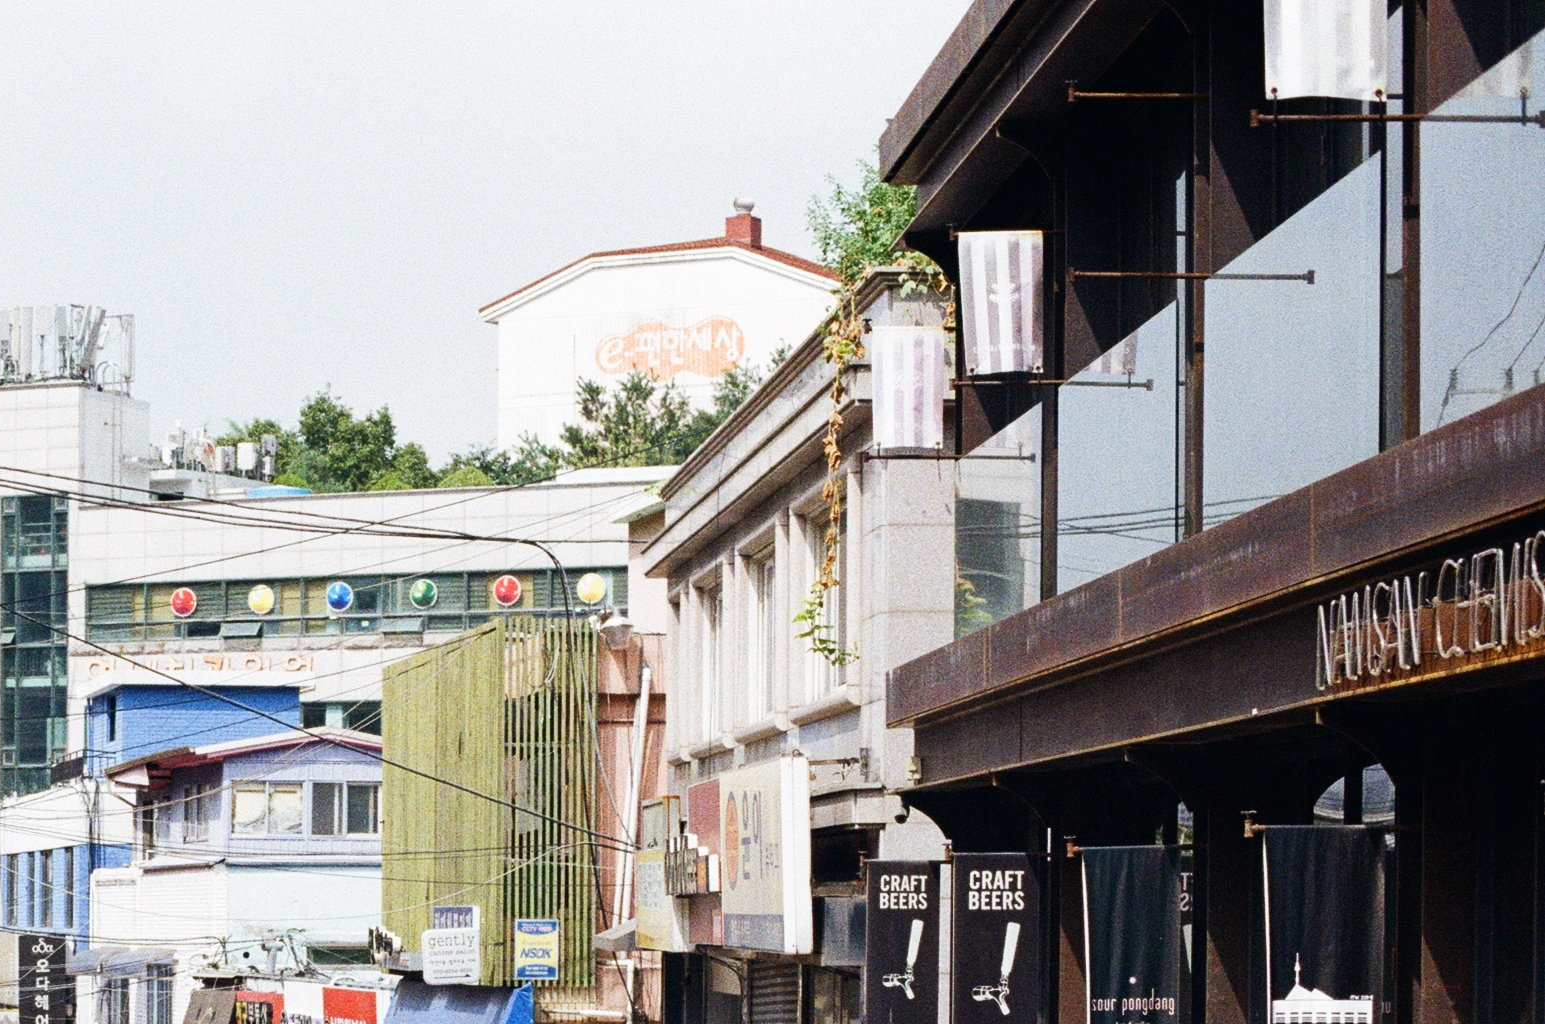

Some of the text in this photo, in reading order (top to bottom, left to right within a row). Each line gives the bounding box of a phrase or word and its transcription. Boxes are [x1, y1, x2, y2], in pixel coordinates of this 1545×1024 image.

[598, 325, 742, 370] e-편한세상
[880, 874, 928, 892] CRAFT
[969, 870, 1025, 890] CRAFT
[879, 892, 928, 910] BEERS
[968, 891, 1025, 911] BEERS
[428, 933, 475, 949] gently
[1091, 988, 1176, 1016] sour pongdang
